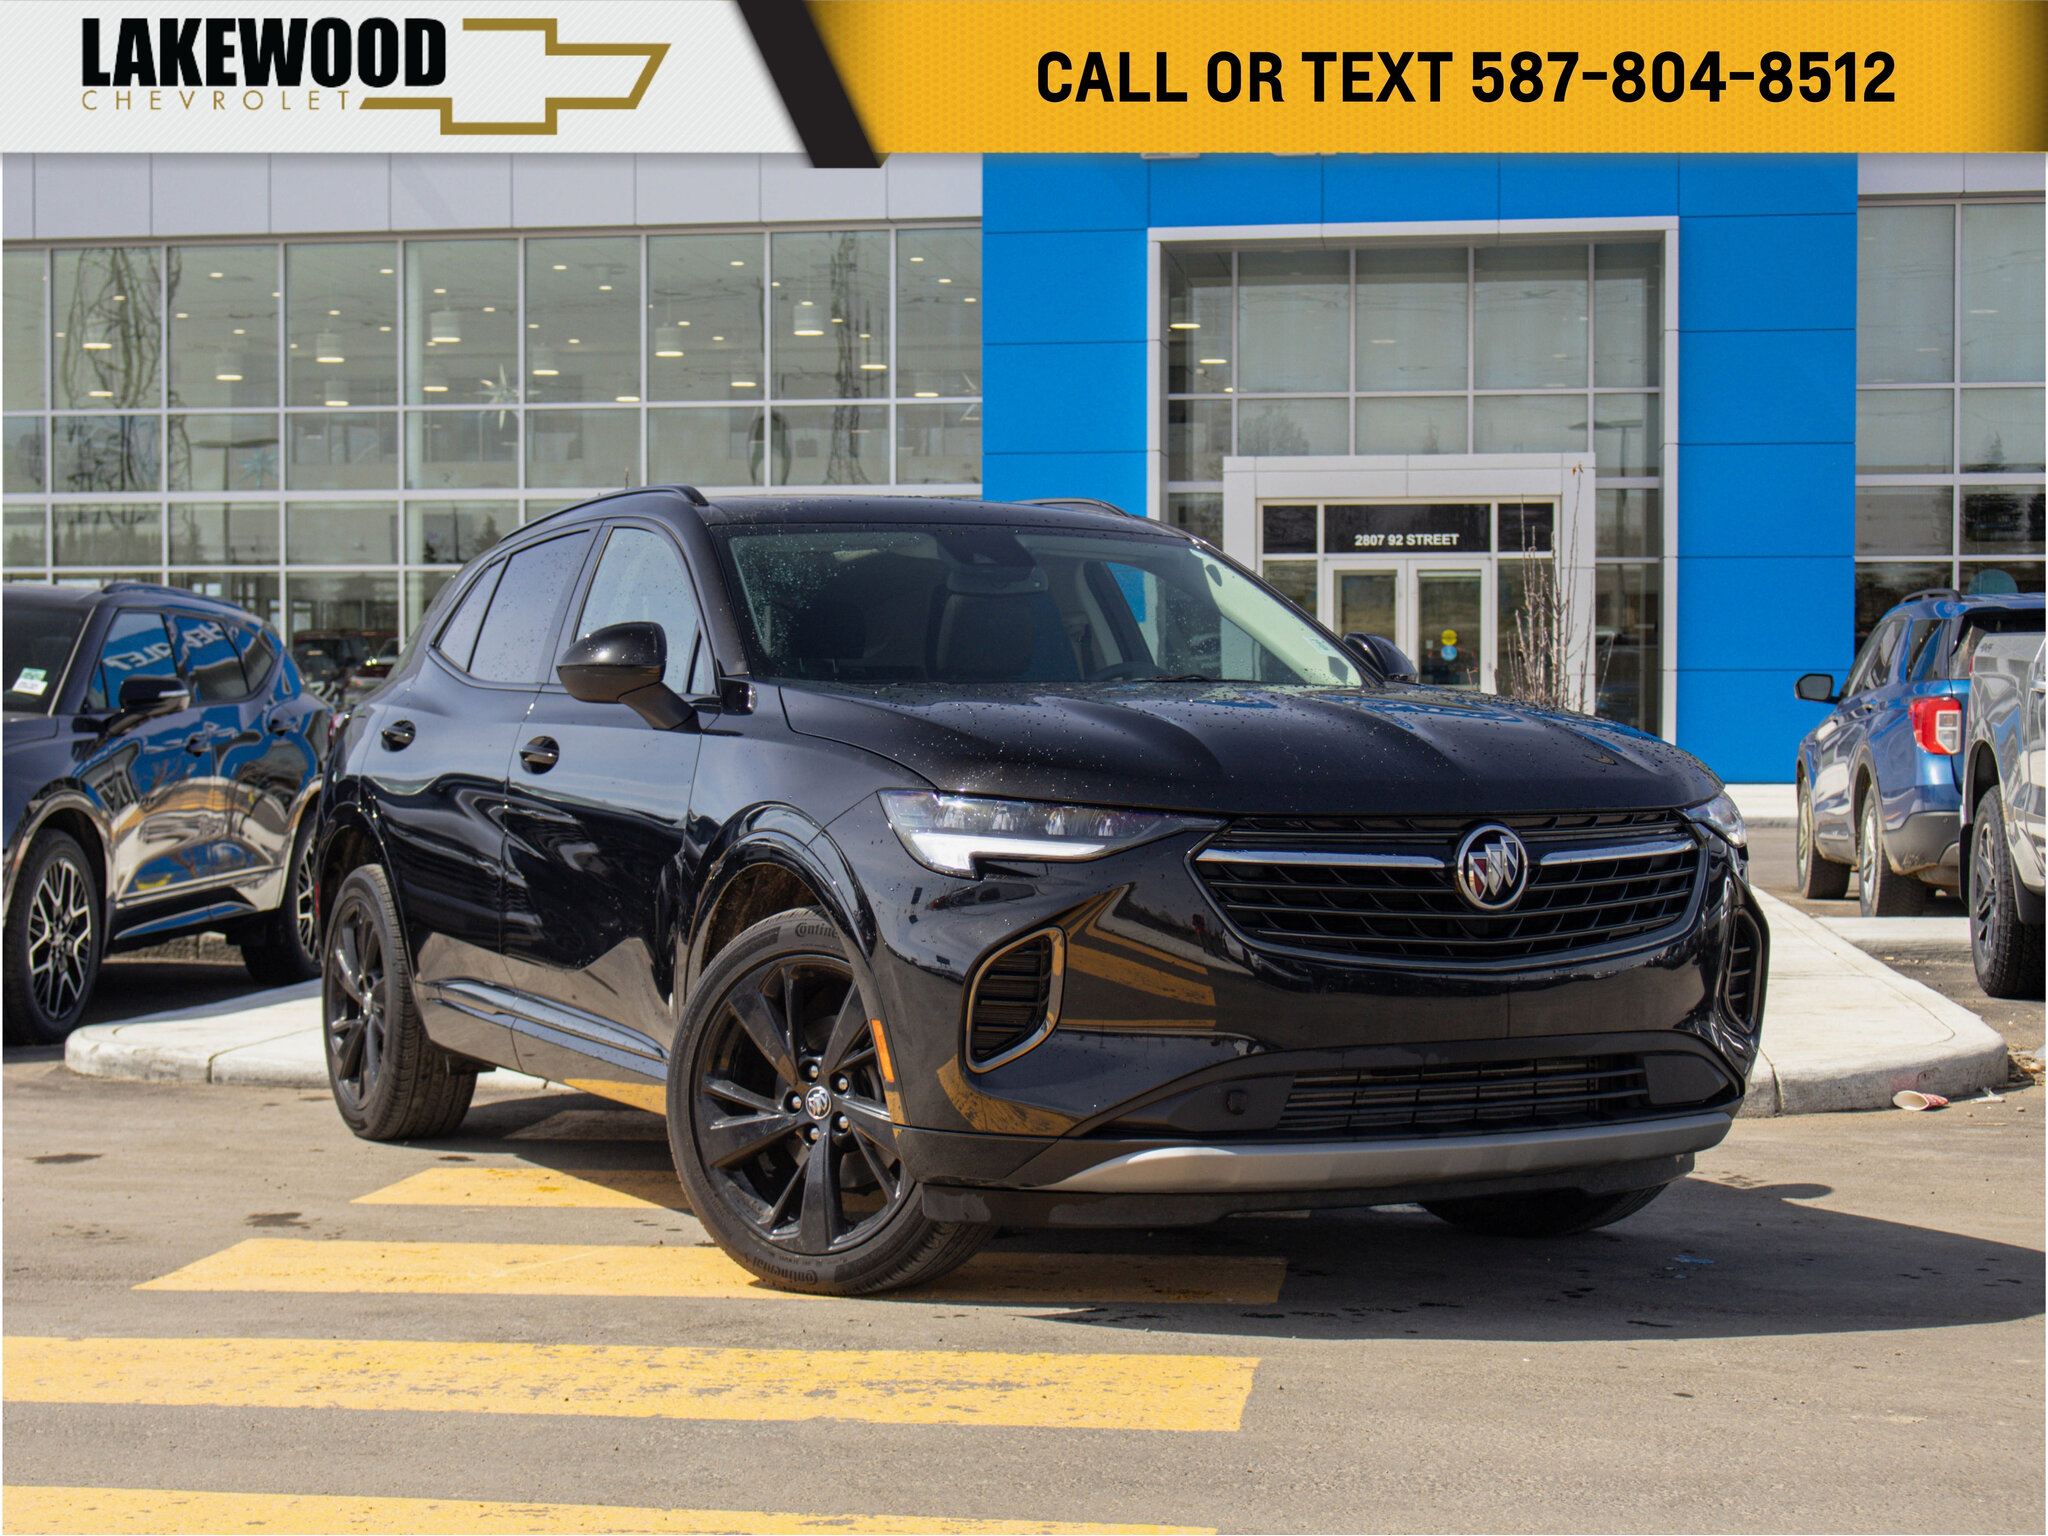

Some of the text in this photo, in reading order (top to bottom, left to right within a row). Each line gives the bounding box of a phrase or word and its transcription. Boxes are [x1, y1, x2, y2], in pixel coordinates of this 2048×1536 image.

[1354, 533, 1460, 547] 2807 92 STREET
[752, 1256, 818, 1286] Continental
